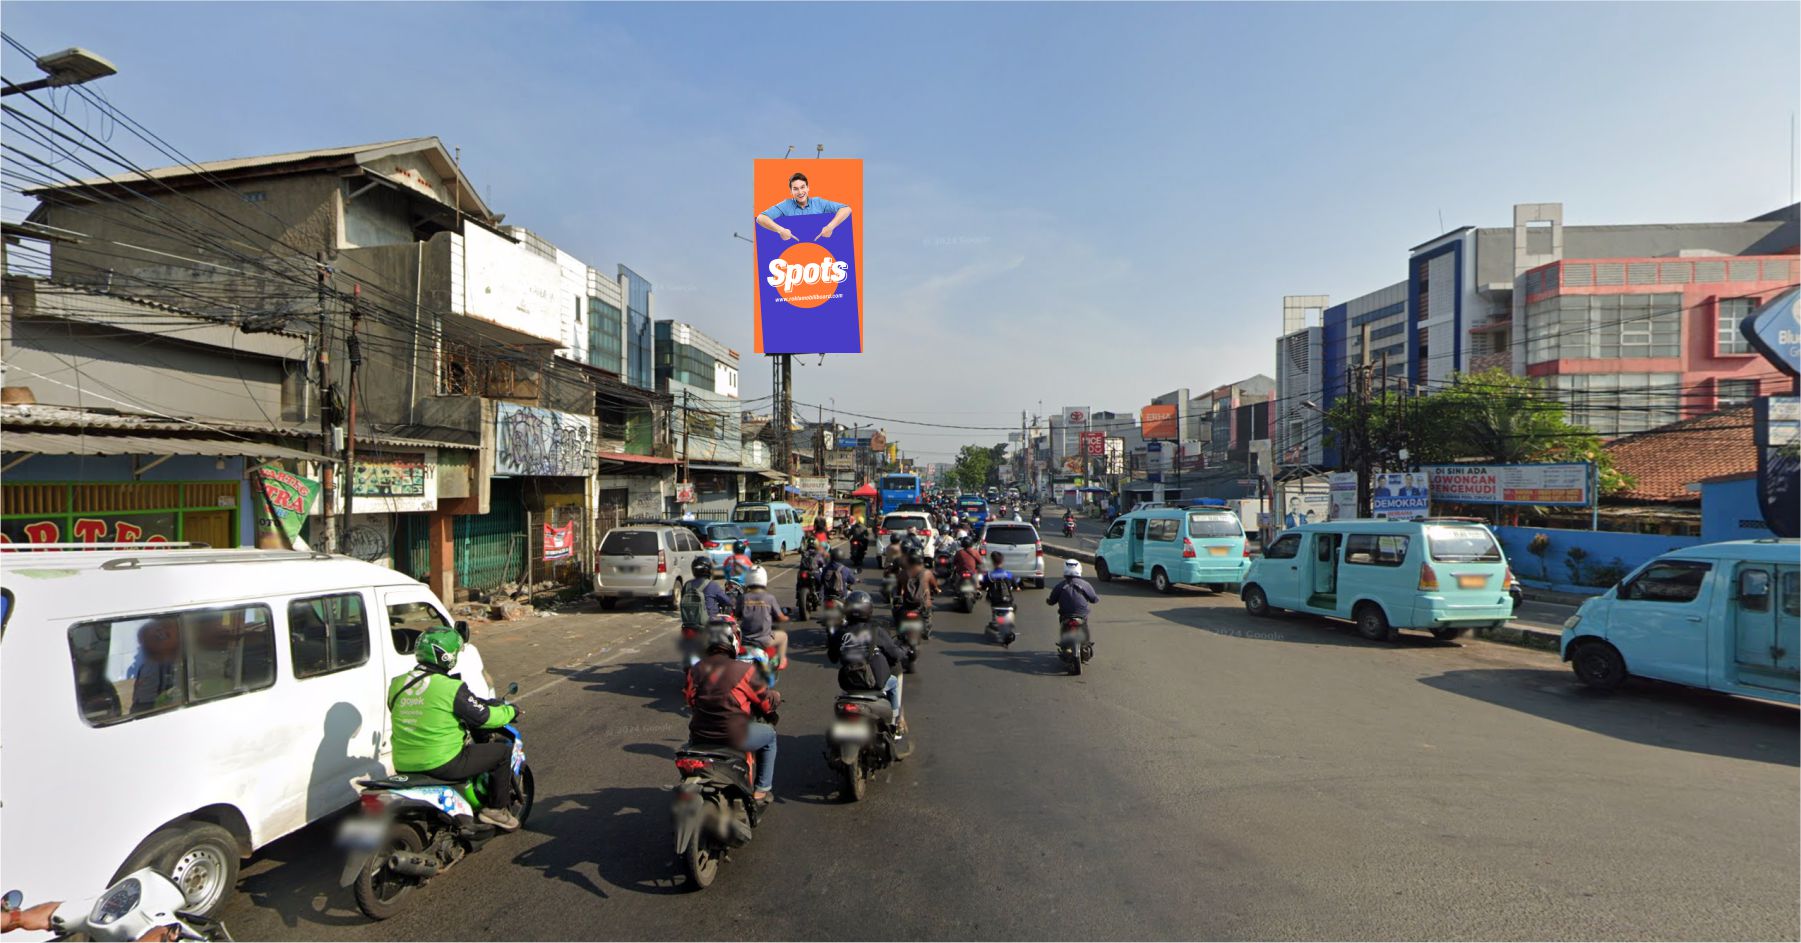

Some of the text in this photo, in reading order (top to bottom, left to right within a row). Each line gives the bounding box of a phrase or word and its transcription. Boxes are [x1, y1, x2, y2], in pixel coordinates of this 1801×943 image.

[767, 257, 848, 293] Spots
[1436, 467, 1445, 475] DI
[1447, 467, 1464, 475] SINI
[1375, 498, 1427, 508] DEMOKRAT
